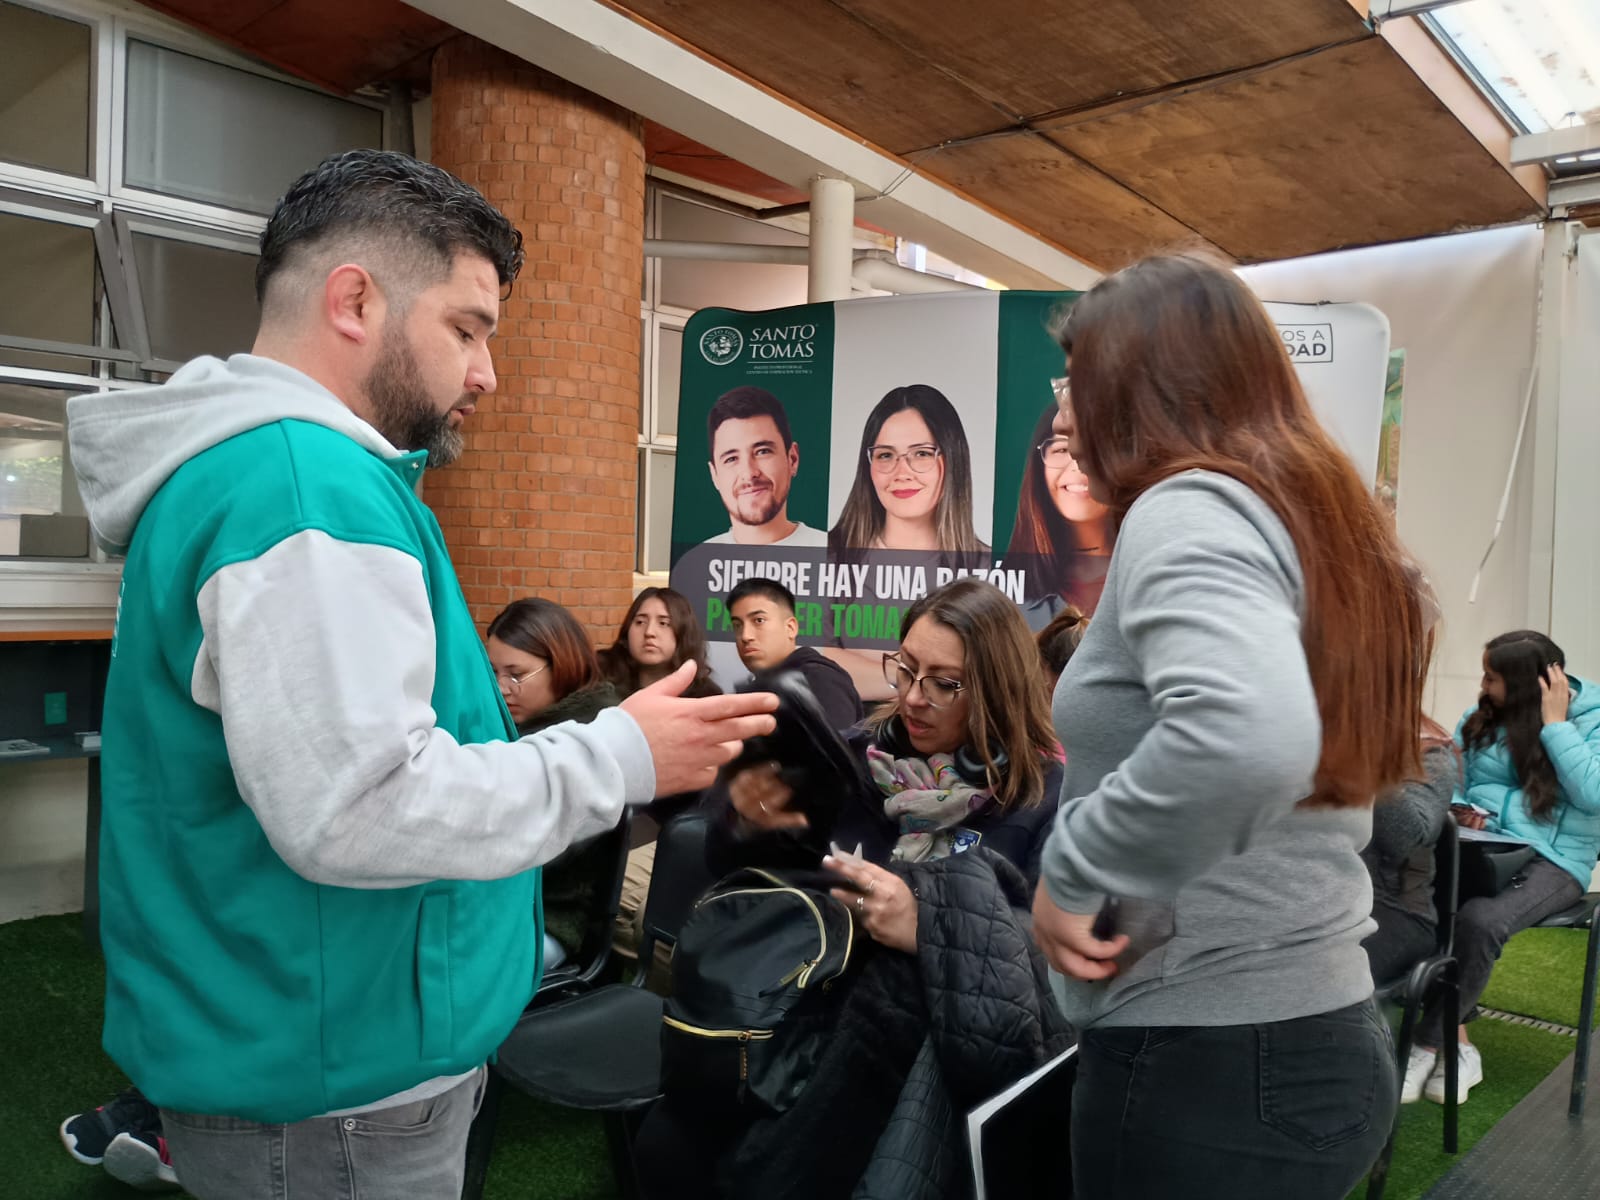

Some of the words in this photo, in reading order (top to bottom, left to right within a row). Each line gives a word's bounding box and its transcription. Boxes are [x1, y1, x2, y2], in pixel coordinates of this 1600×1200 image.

[750, 324, 815, 342] SANTO
[1281, 329, 1306, 342] OS
[1312, 329, 1325, 341] A
[1286, 343, 1327, 357] DAD
[708, 558, 812, 596] SIEMPRE
[818, 563, 867, 598] HAY
[875, 564, 928, 600] UNA
[795, 601, 823, 636] ER
[830, 603, 911, 641] TOMA
